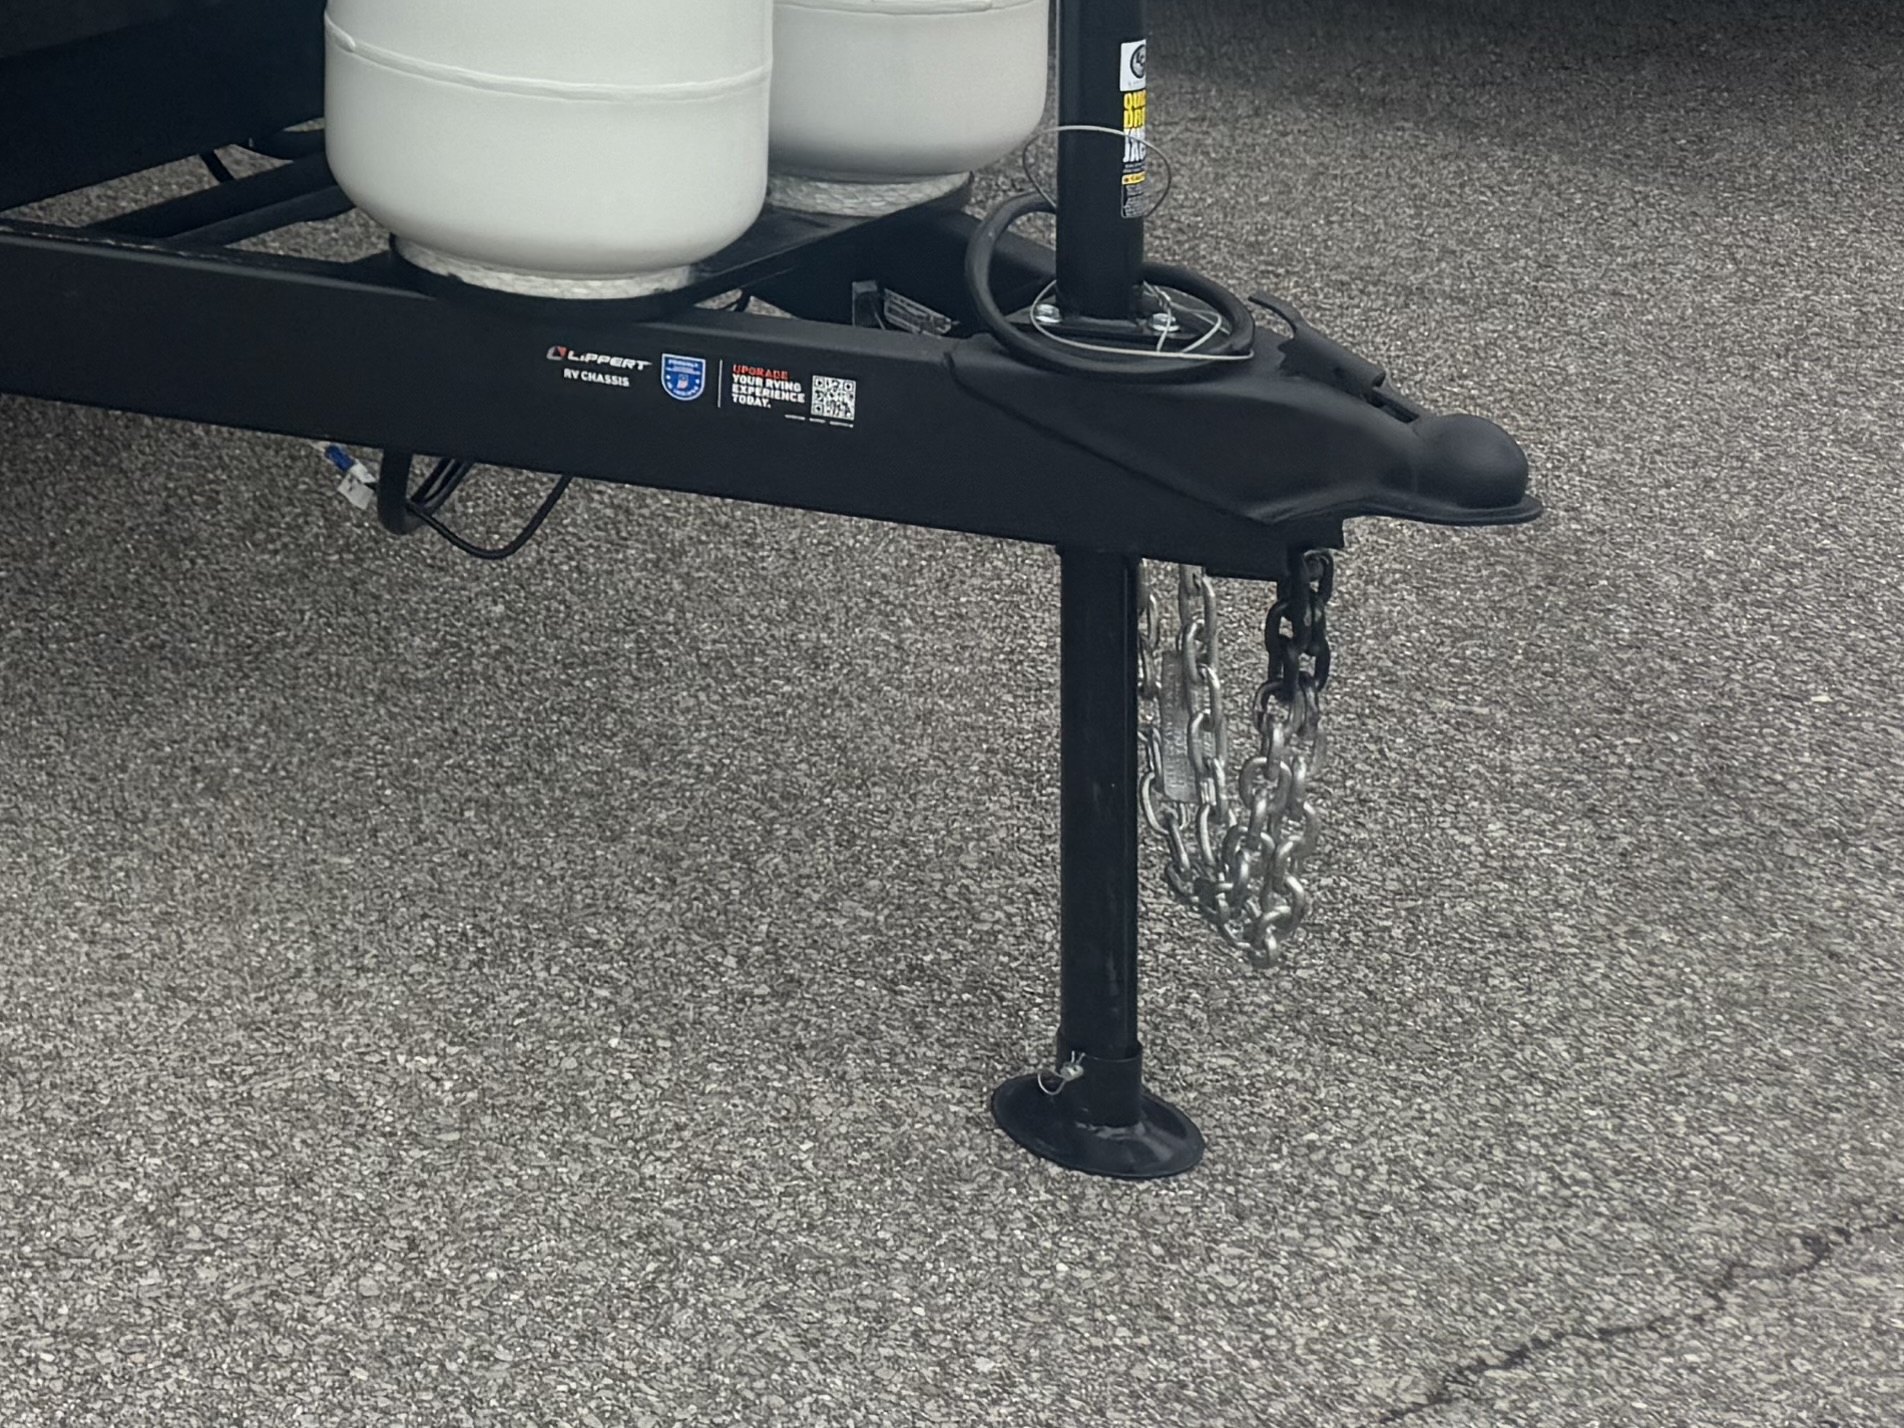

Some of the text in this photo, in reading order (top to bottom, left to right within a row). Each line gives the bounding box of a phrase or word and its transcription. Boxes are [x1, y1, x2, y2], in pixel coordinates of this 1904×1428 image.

[563, 368, 630, 387] RV CHASSIS
[733, 364, 789, 380] UPGRADE
[733, 373, 802, 393] YOUR RVING
[732, 383, 806, 403] EXPERIENCE
[732, 393, 771, 409] TODAY.
